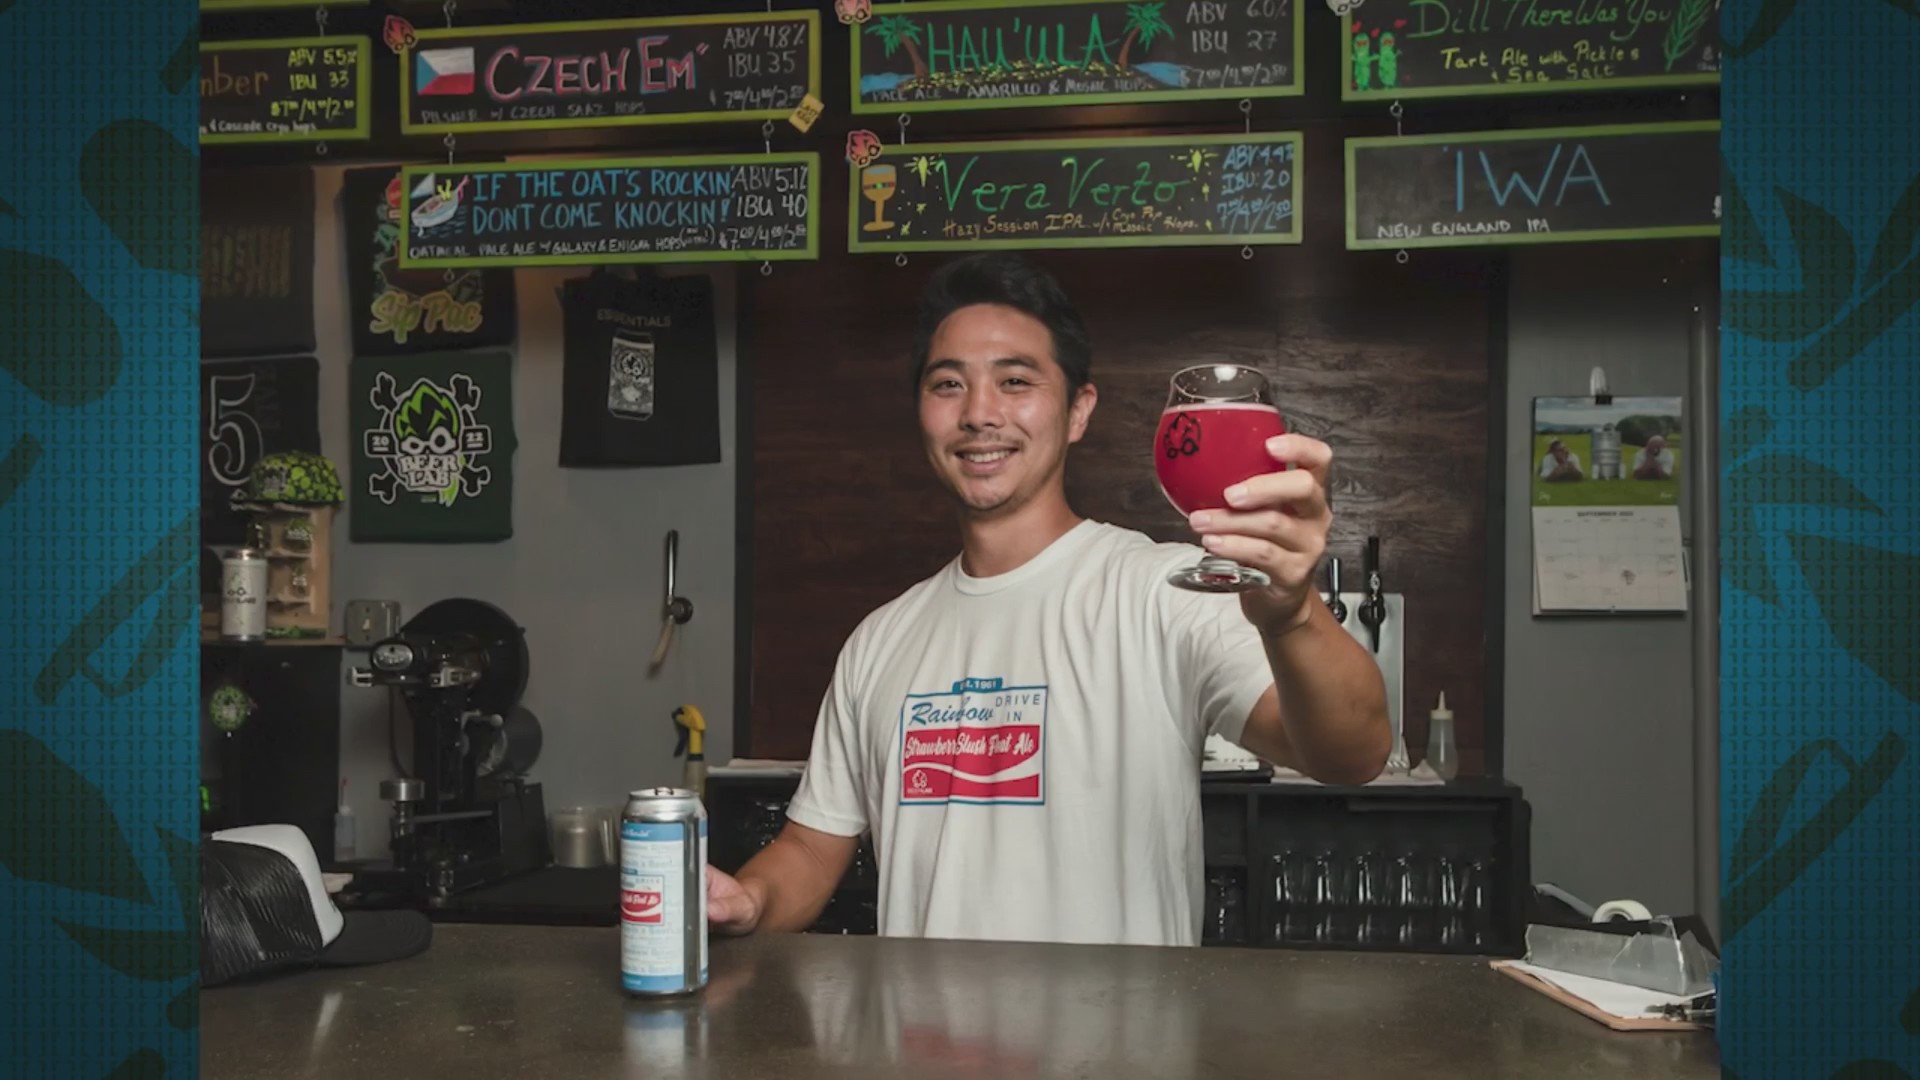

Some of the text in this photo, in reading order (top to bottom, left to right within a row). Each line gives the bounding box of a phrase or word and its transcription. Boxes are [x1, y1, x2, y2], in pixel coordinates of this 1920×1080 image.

[1186, 1, 1227, 24] ABV
[1405, 0, 1490, 38] Dill
[722, 27, 760, 50] ABV
[1191, 29, 1278, 53] IBU 27
[287, 48, 316, 68] ABV
[727, 50, 796, 78] IBU 35
[1440, 47, 1488, 69] Tart
[1500, 47, 1530, 67] Ale
[289, 70, 350, 91] IBU 33
[484, 44, 631, 102] CZECH
[1506, 66, 1550, 82] Sea
[1566, 62, 1616, 80] Salt
[966, 82, 1041, 99] AMARILLO
[1049, 79, 1060, 94] &
[510, 105, 556, 120] CZECH
[473, 173, 507, 202] IF
[515, 171, 565, 199] THE
[571, 168, 642, 198] OAT'S
[731, 165, 773, 191] ABV
[936, 155, 1191, 212] Vera Verto
[1260, 168, 1291, 190] 20
[540, 201, 602, 229] COME
[737, 193, 808, 218] IBU 40
[942, 219, 981, 240] Hazy
[983, 214, 1039, 234] Session
[1376, 217, 1550, 239] NEW ENGLAND IPA
[512, 241, 536, 256] ALE
[551, 241, 598, 256] GALAXY
[369, 290, 424, 344] Sip
[208, 373, 263, 487] 5
[372, 435, 390, 447] 20
[466, 431, 484, 443] 22
[399, 453, 459, 474] BEER
[407, 469, 451, 488] LAB
[995, 694, 1041, 708] DRIVE
[1007, 711, 1022, 723] IN
[1012, 732, 1034, 756] Ale
